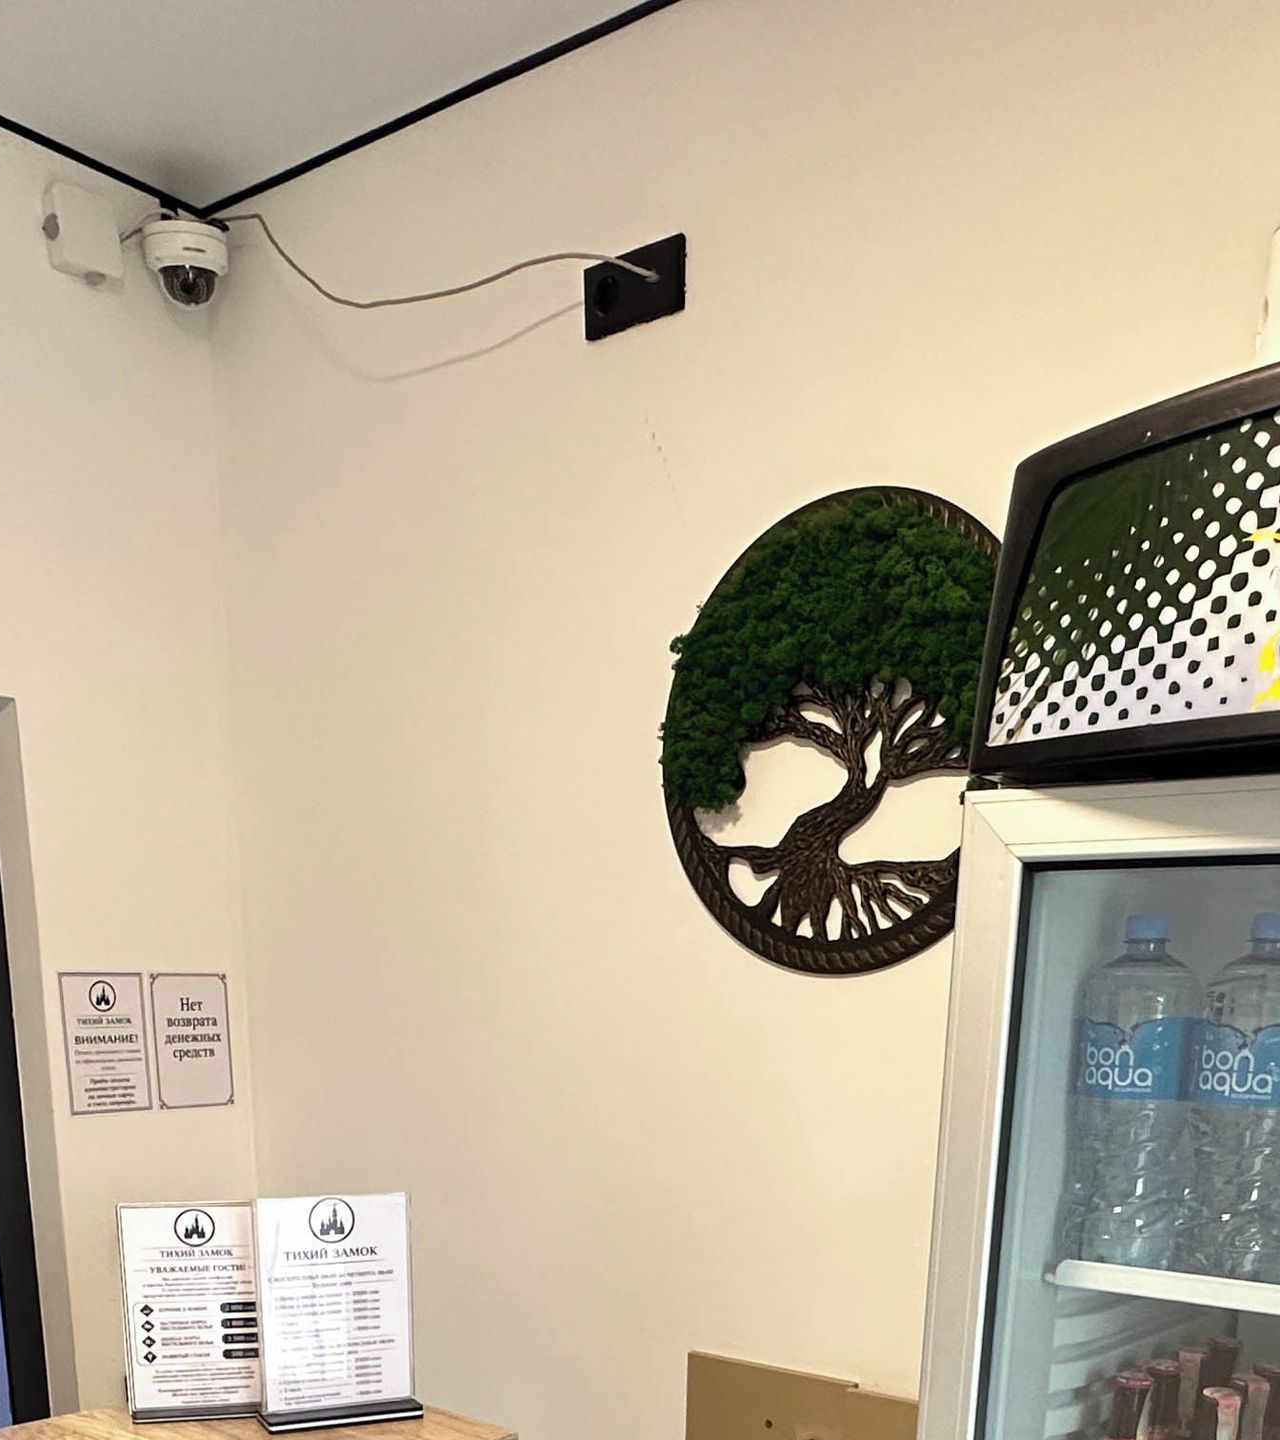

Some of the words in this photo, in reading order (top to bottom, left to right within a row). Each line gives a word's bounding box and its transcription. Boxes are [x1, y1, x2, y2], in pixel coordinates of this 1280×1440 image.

[179, 997, 203, 1012] Нет
[167, 1016, 218, 1030] возврата
[74, 1033, 139, 1045] ВНИМАНИЕ!
[164, 1033, 222, 1045] денежных
[172, 1047, 216, 1062] средств
[1086, 1042, 1135, 1066] bon
[1202, 1045, 1255, 1072] bon
[1085, 1067, 1153, 1090] aqua
[1199, 1070, 1273, 1097] aqua
[159, 1248, 196, 1258] ТИХИЙ
[198, 1249, 234, 1257] ЗАМОК
[283, 1248, 329, 1261] ТИХИЙ
[333, 1246, 378, 1259] ЗАМОК
[149, 1265, 211, 1274] УВАЖАЕМЫЕ
